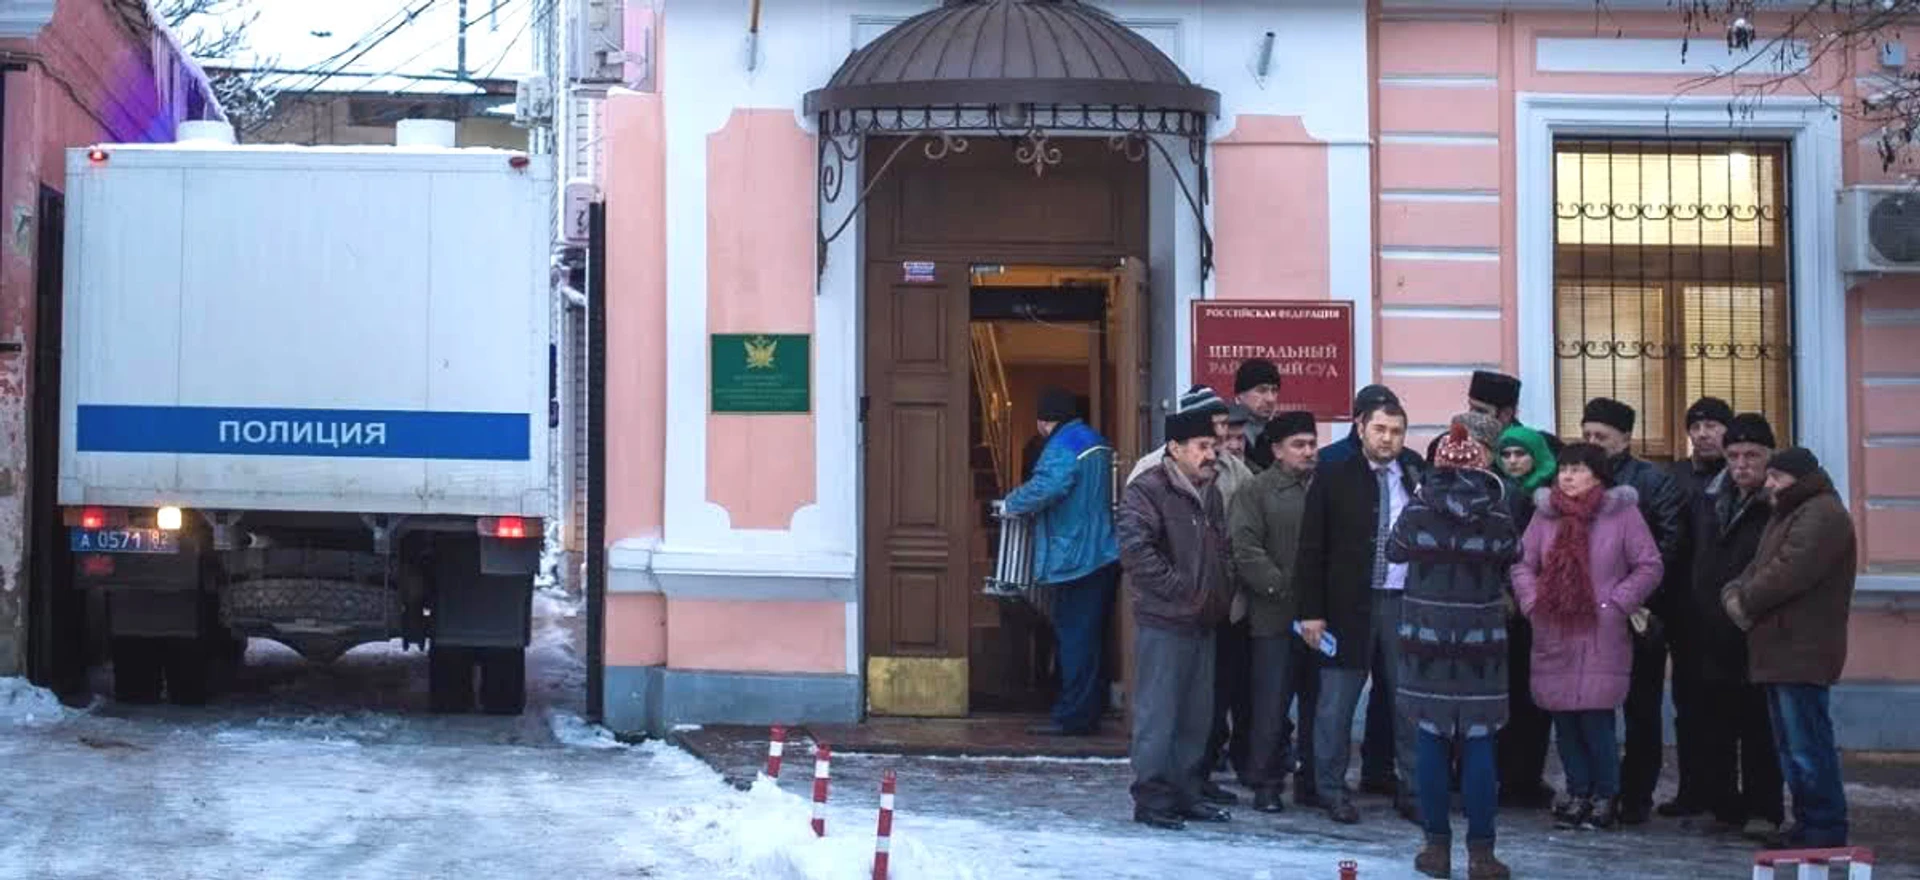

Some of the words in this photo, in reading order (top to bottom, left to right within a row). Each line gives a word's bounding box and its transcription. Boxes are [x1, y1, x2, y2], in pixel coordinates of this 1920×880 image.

[1206, 308, 1276, 318] РОССИЙСКАЯ
[1278, 309, 1340, 319] ФЕДЕРАЦИЯ
[1208, 344, 1338, 359] ЦЕНТРАЛЬНЫЙ
[1208, 361, 1303, 375] РАЙЫЙ
[1306, 363, 1338, 378] СУД
[219, 420, 386, 449] ПОЛИЦИЯ
[97, 530, 142, 549] 0571
